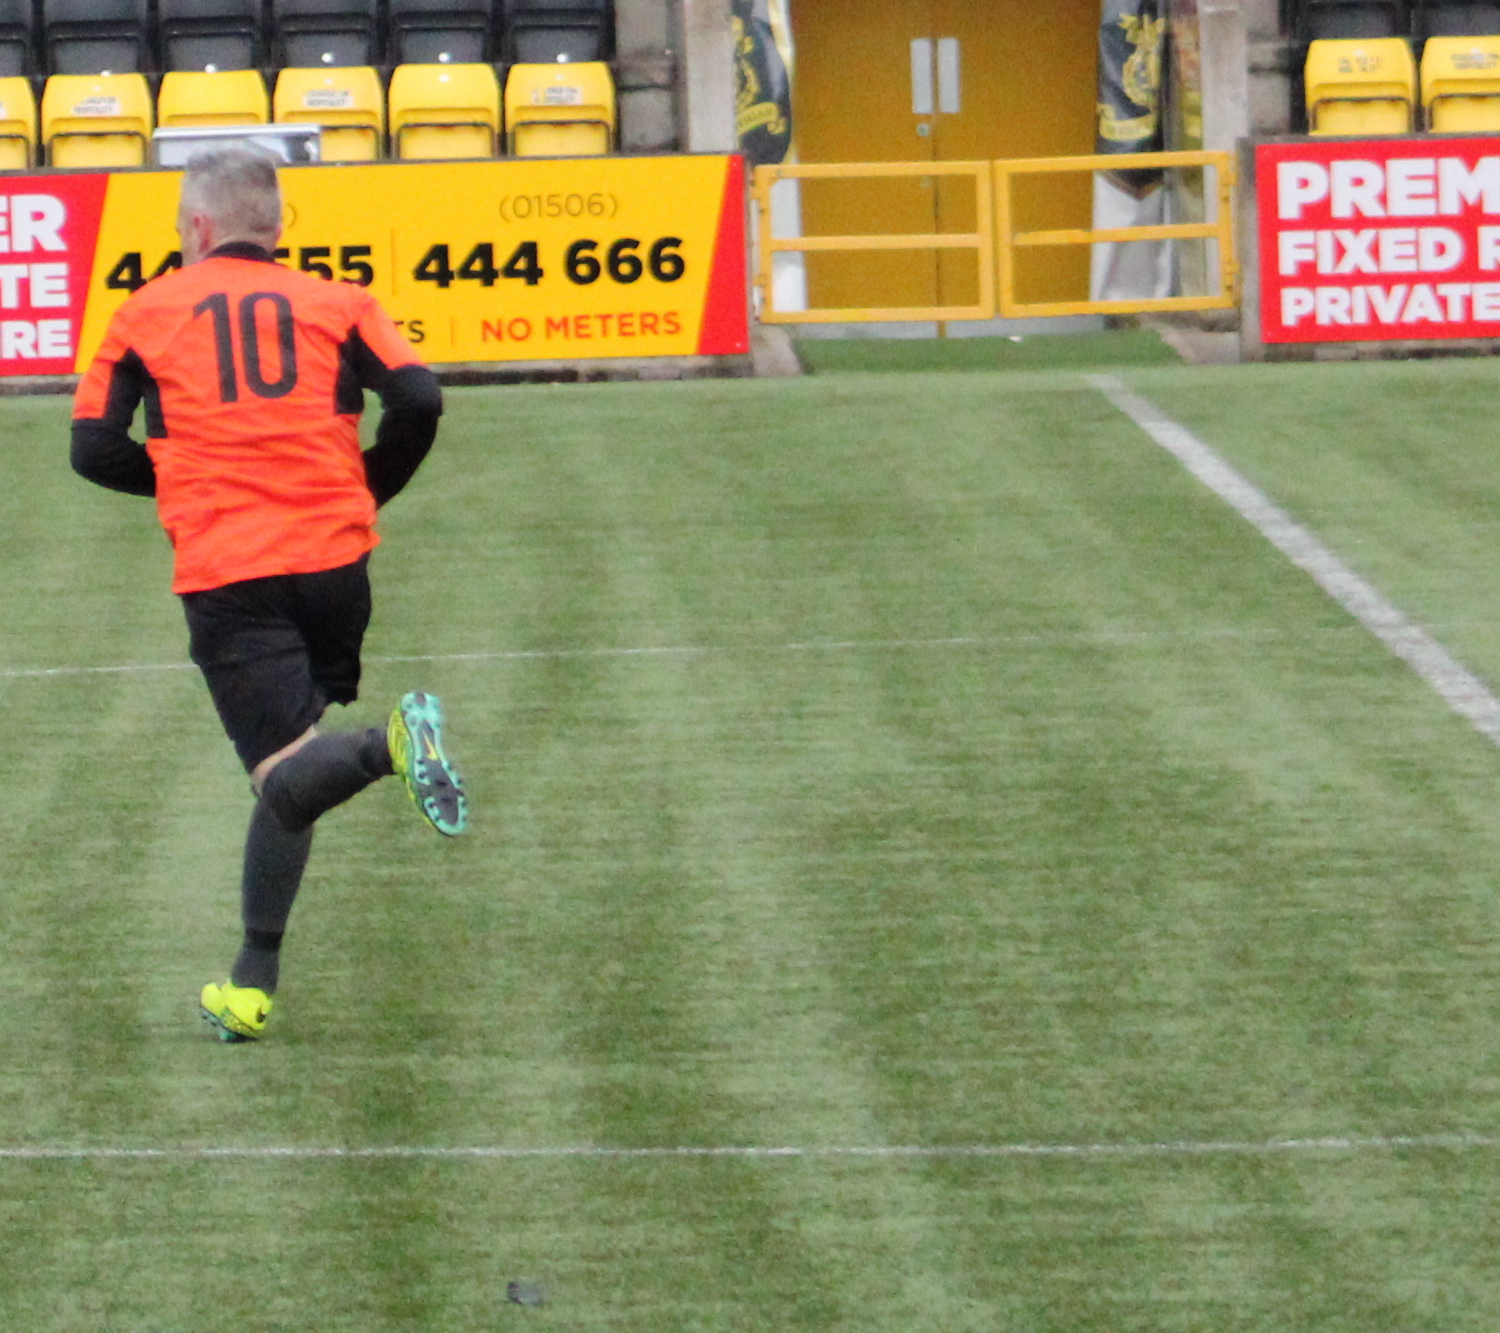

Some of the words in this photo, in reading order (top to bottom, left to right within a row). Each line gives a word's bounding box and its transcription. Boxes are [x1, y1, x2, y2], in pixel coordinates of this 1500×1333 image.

[498, 192, 620, 222] (01506)
[274, 245, 374, 287] 55
[413, 241, 544, 287] 444
[563, 236, 686, 284] 666
[1279, 228, 1466, 277] FIXED
[193, 290, 298, 404] 10
[480, 315, 534, 345] NO
[546, 309, 682, 341] METERS
